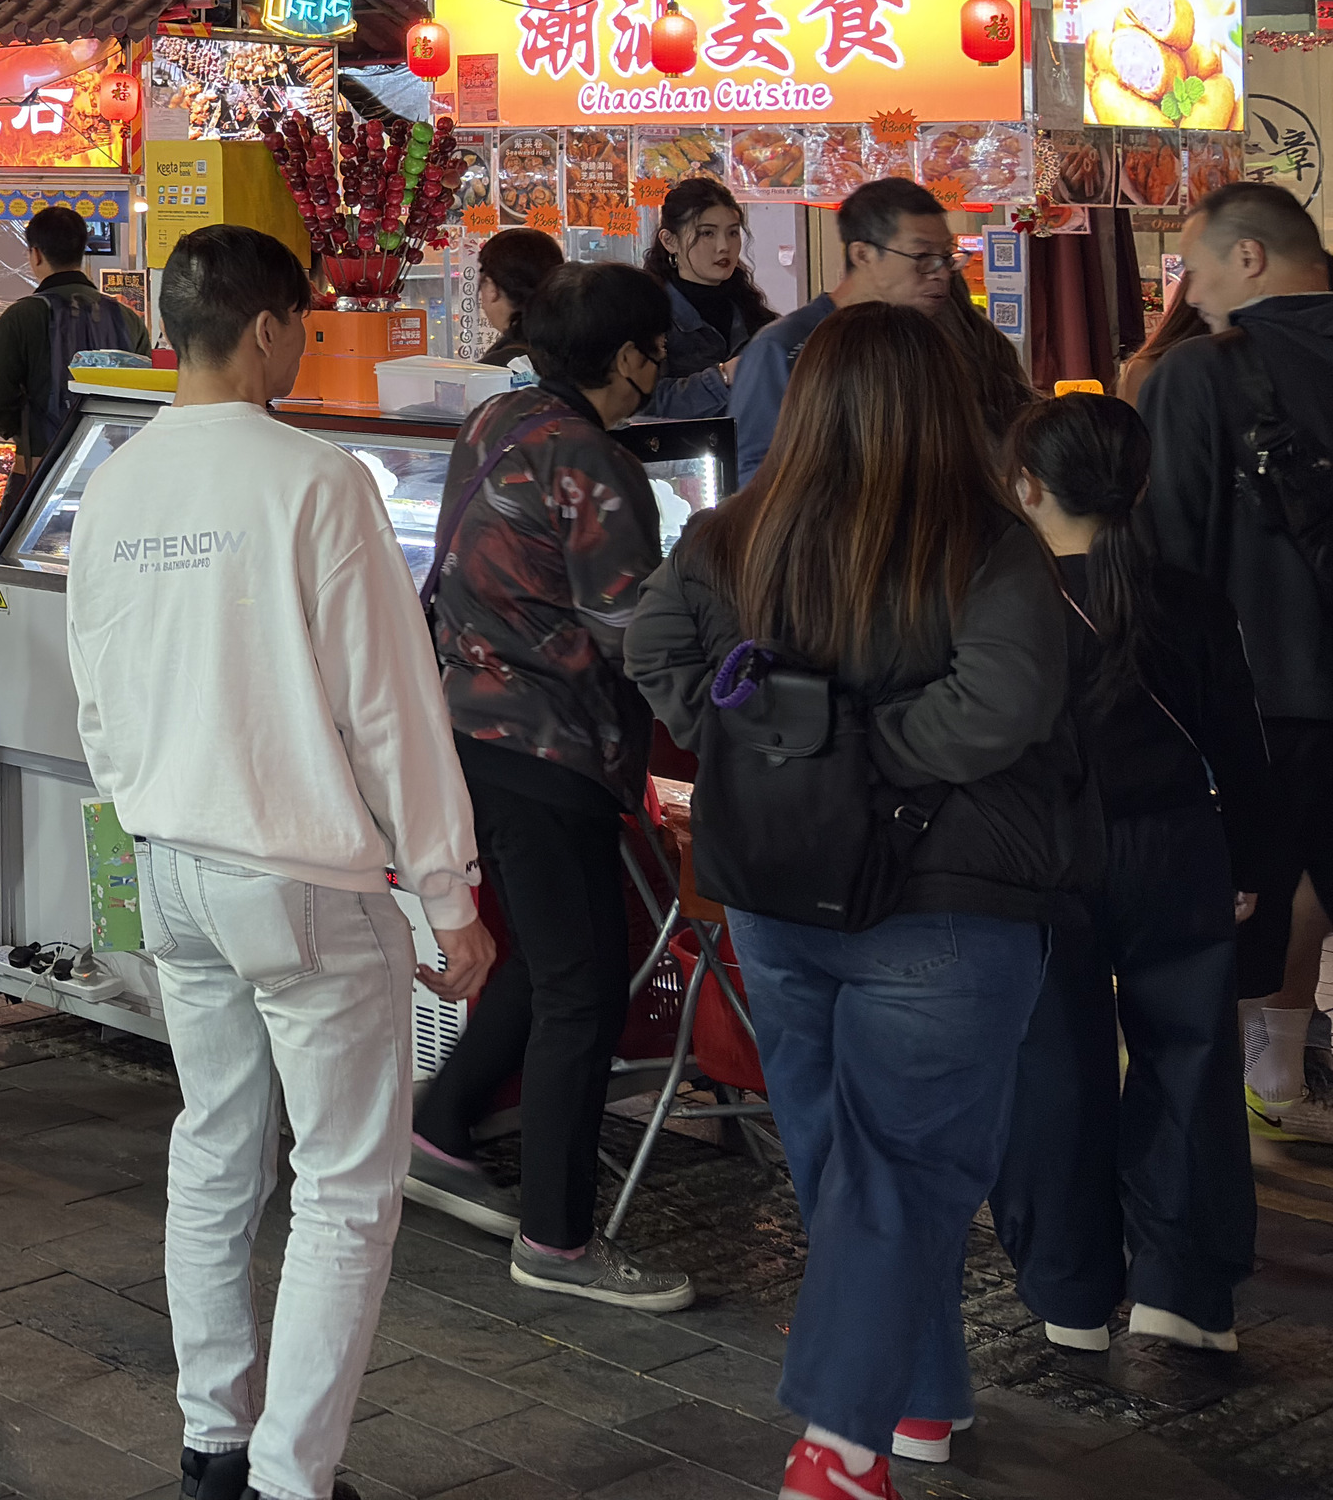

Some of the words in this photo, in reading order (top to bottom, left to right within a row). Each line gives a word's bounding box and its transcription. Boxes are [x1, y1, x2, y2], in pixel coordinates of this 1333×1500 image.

[580, 81, 710, 113] Chaoshan
[717, 76, 832, 111] Cuisine
[156, 160, 179, 178] keeta
[162, 559, 191, 572] BATHING
